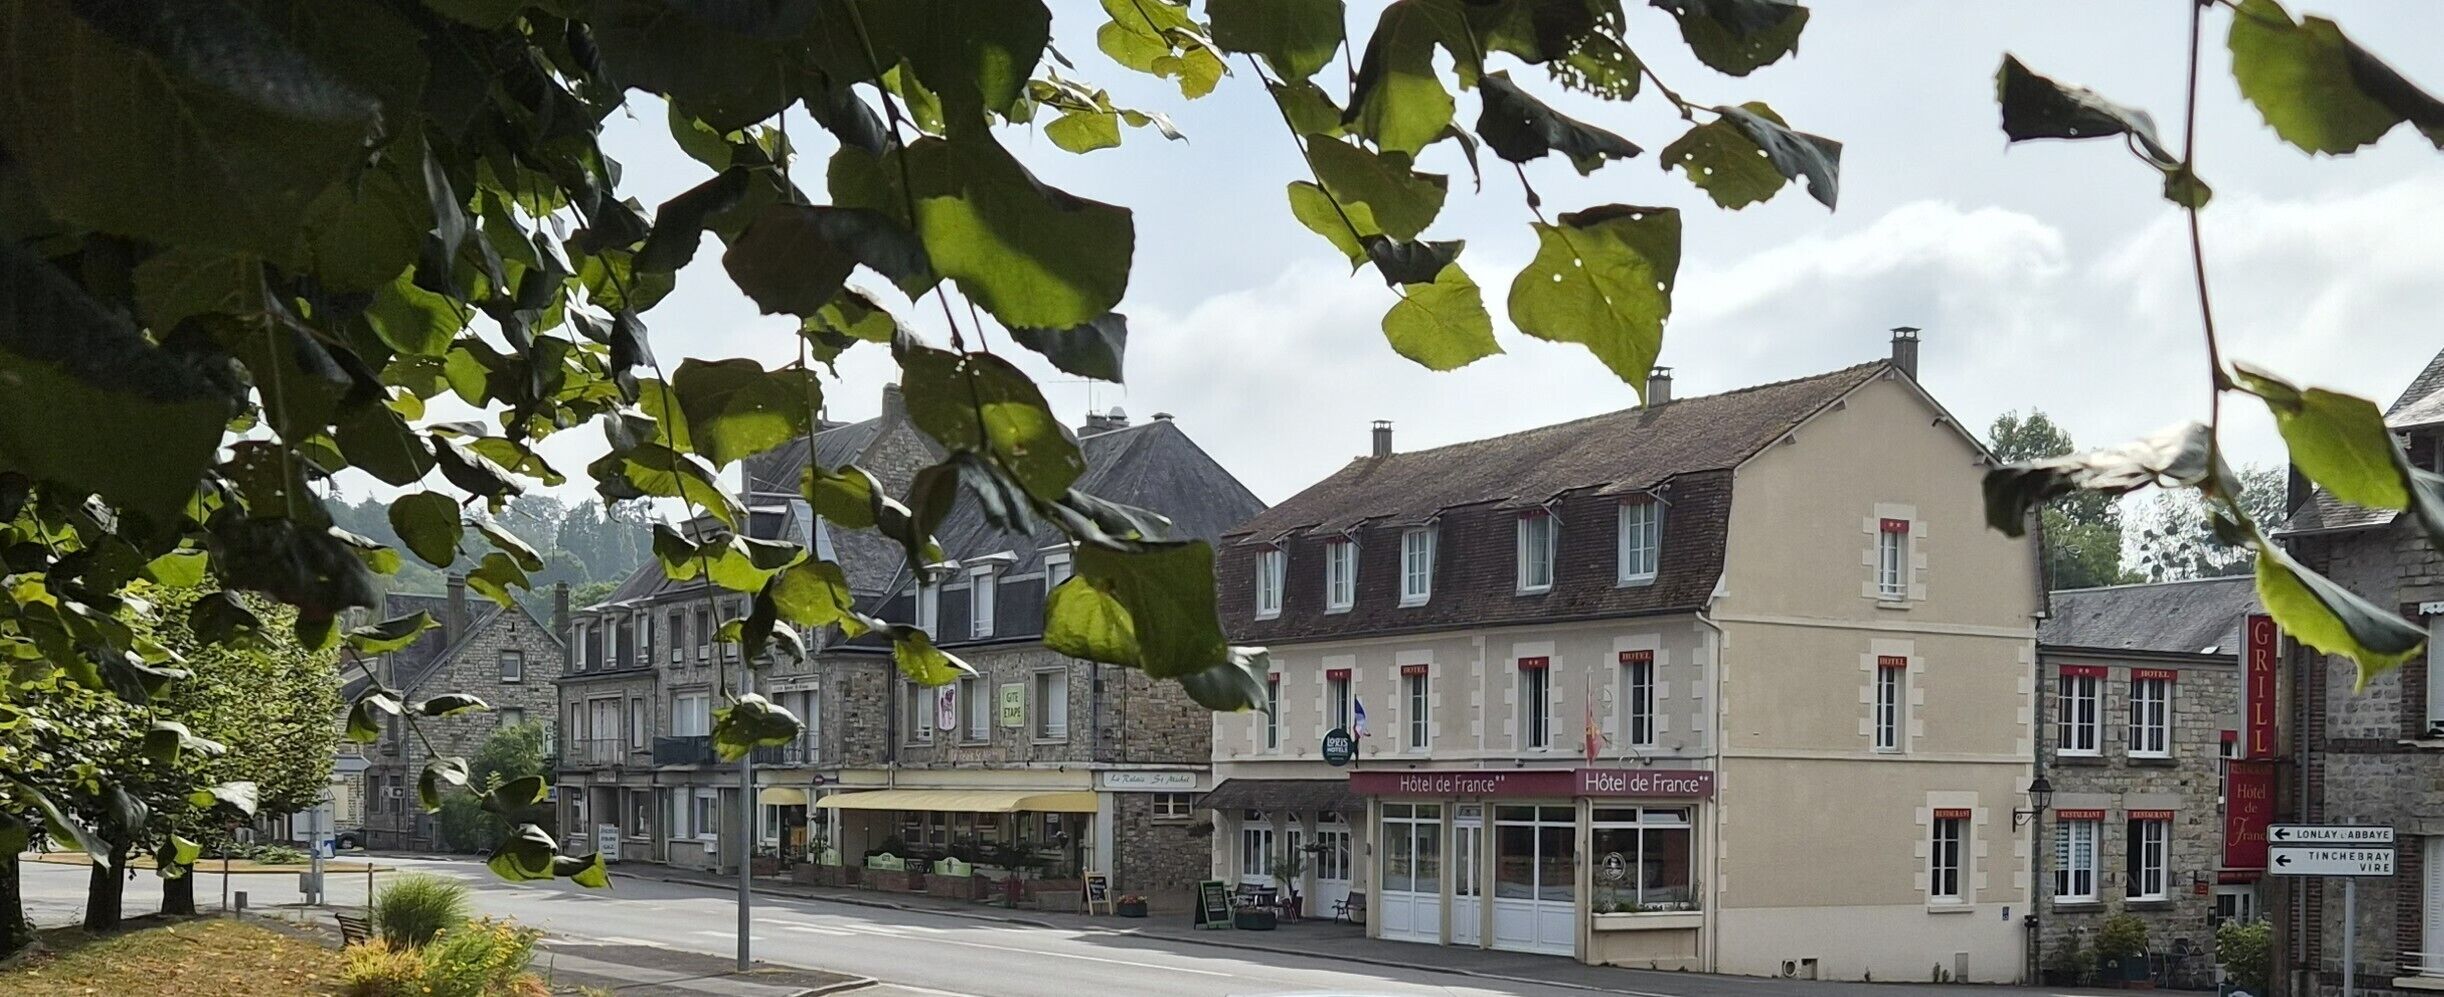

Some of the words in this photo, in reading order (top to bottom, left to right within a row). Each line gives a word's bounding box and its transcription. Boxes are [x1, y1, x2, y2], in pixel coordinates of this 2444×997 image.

[2140, 669, 2170, 678] HOTEL
[2254, 621, 2270, 753] GRILL
[1400, 775, 1432, 792] Hôtel
[1436, 775, 1450, 792] de
[1455, 775, 1495, 793] France
[1585, 772, 1626, 792] Hôtel
[1630, 773, 1649, 792] de
[1653, 774, 1699, 793] France
[2244, 801, 2257, 813] de
[2228, 816, 2266, 847] Franc
[2297, 830, 2337, 839] LONLAY
[2308, 851, 2390, 861] TINCHEBRAY
[2360, 863, 2390, 872] VIRE
